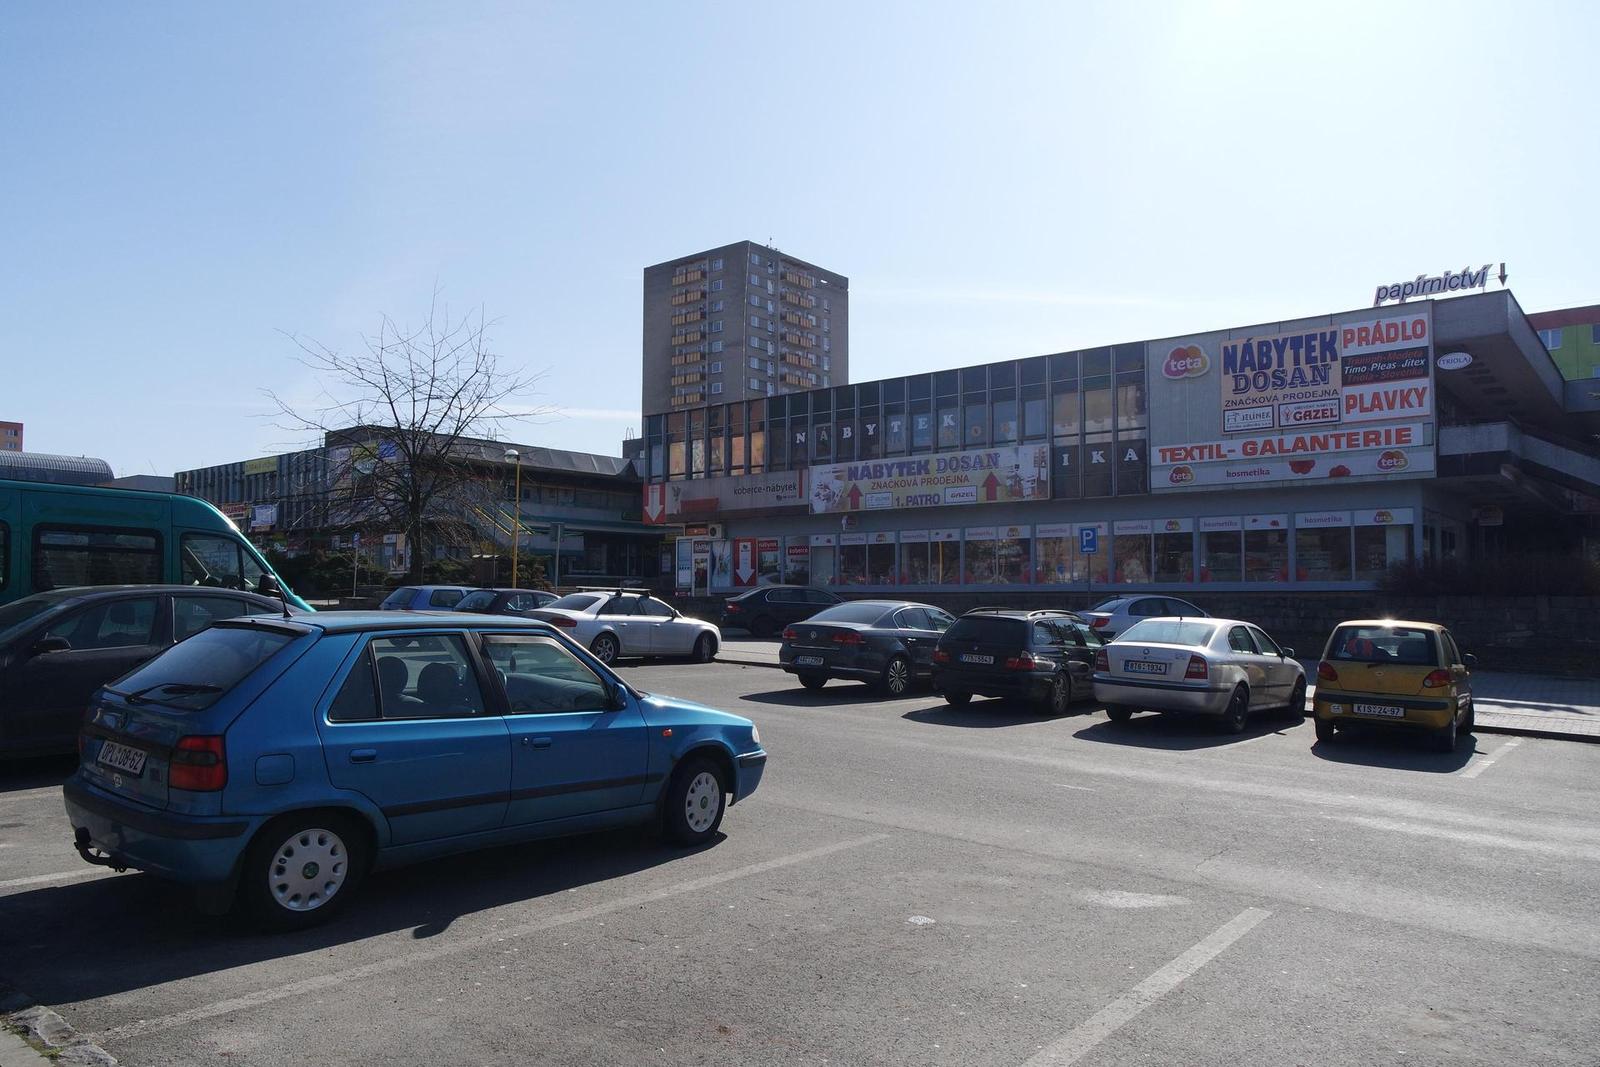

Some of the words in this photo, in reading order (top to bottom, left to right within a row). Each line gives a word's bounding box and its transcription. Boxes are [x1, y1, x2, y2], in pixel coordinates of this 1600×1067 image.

[1375, 264, 1490, 306] papírnictví
[1343, 319, 1426, 349] PRÁDLO
[1223, 330, 1338, 375] NÁBYTEK
[1170, 355, 1203, 371] teta
[1344, 366, 1367, 375] Timo
[1371, 361, 1397, 371] Pleas
[1402, 356, 1426, 368] Jitex
[1232, 363, 1331, 394] DOSAN
[1282, 389, 1339, 401] PRODEJNA
[1345, 386, 1428, 414] PLAVKY
[1293, 408, 1338, 421] GAZEL
[1242, 427, 1412, 457] GALANTERIE
[847, 459, 930, 481] NÁBYTEK
[935, 452, 1000, 474] DOSAN
[1382, 457, 1405, 467] teta
[921, 474, 970, 486] PRODEJNA
[1172, 472, 1192, 482] teta
[1226, 468, 1270, 479] kosmetika
[906, 493, 941, 506] PATRO
[1083, 530, 1093, 546] P
